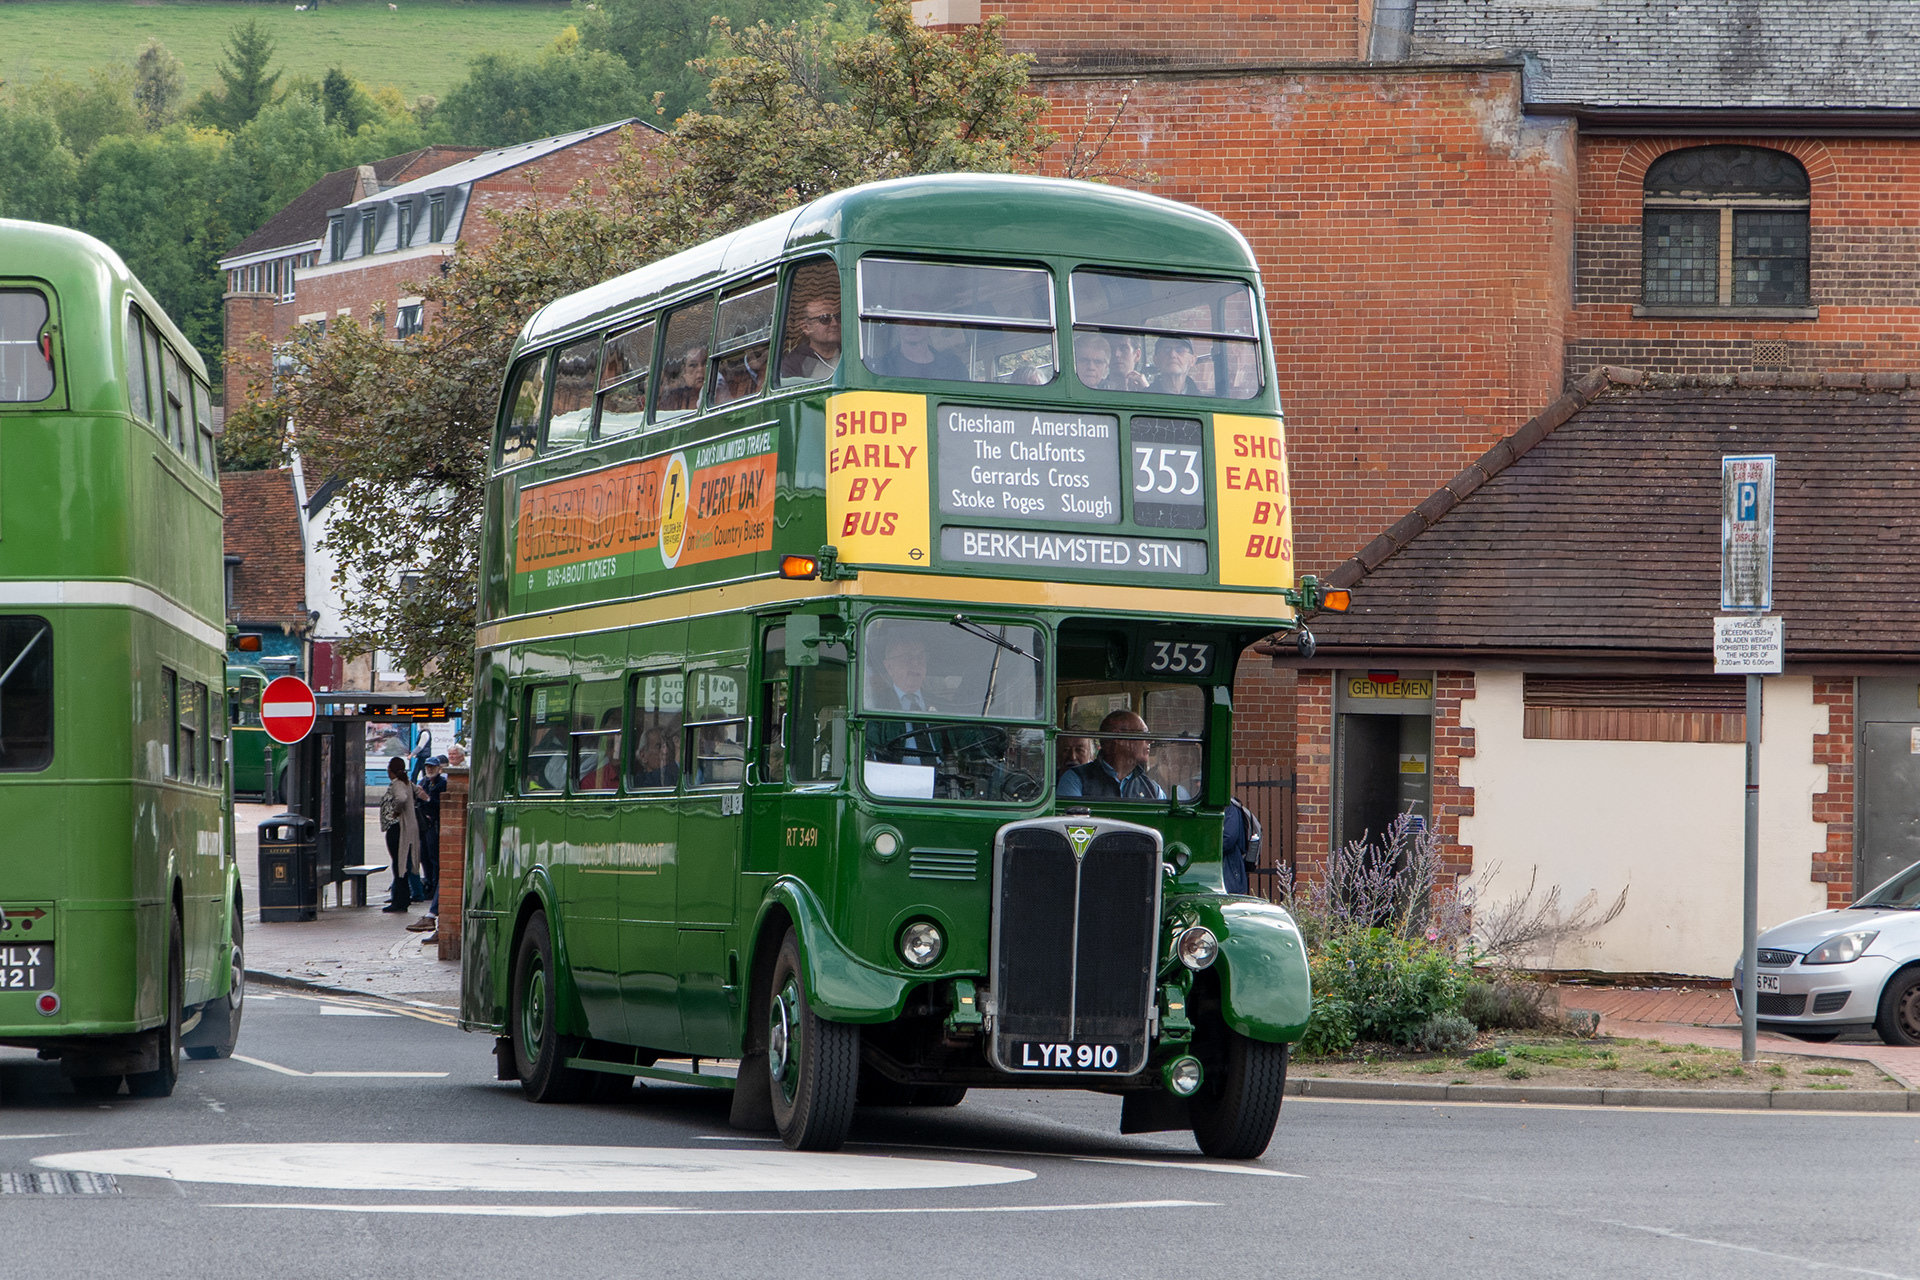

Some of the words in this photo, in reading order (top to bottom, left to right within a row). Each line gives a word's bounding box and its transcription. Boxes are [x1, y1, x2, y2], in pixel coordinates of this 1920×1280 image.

[835, 410, 907, 438] SHOP
[948, 412, 1015, 435] Chesham
[1031, 416, 1109, 439] Amersham
[716, 438, 746, 464] UNLIMITED
[746, 432, 771, 456] TRAVEL
[830, 444, 918, 474] EARLY
[973, 440, 1003, 461] The
[1009, 441, 1086, 464] Chalfonts
[970, 466, 1040, 487] Gerrards
[1047, 468, 1090, 488] Cross
[1135, 447, 1200, 495] 353
[1733, 472, 1746, 480] CAR
[1747, 471, 1763, 480] PARK
[1749, 462, 1765, 471] YARD
[698, 474, 736, 519] EVERY
[738, 468, 765, 511] DAY
[848, 477, 891, 502] BY
[1226, 466, 1290, 497] EARL
[521, 487, 586, 562] GREEN
[588, 470, 659, 551] ROVER
[952, 488, 996, 510] Stoke
[1002, 492, 1045, 515] Poges
[1060, 494, 1112, 518] Slough
[1252, 501, 1288, 526] BY
[1740, 485, 1756, 519] P
[687, 535, 695, 552] on
[713, 525, 743, 549] Country
[743, 519, 765, 542] Buses
[841, 511, 899, 538] BUS
[1732, 523, 1745, 532] PAY
[1735, 532, 1760, 543] DISPLAY
[962, 532, 1131, 566] BERKHAMSTED
[1137, 537, 1182, 569] STN
[1245, 534, 1292, 562] BUS
[547, 564, 587, 588] BUS-ABOUT
[587, 557, 617, 581] TICKETS
[1150, 641, 1209, 673] 353
[1352, 681, 1429, 697] GENTLEMEN
[786, 827, 798, 847] RT
[799, 827, 819, 847] 3491
[579, 842, 613, 873] LONDON
[616, 842, 665, 875] TRANSPORT
[1022, 1043, 1072, 1068] LYR
[1076, 1044, 1118, 1069] 910
